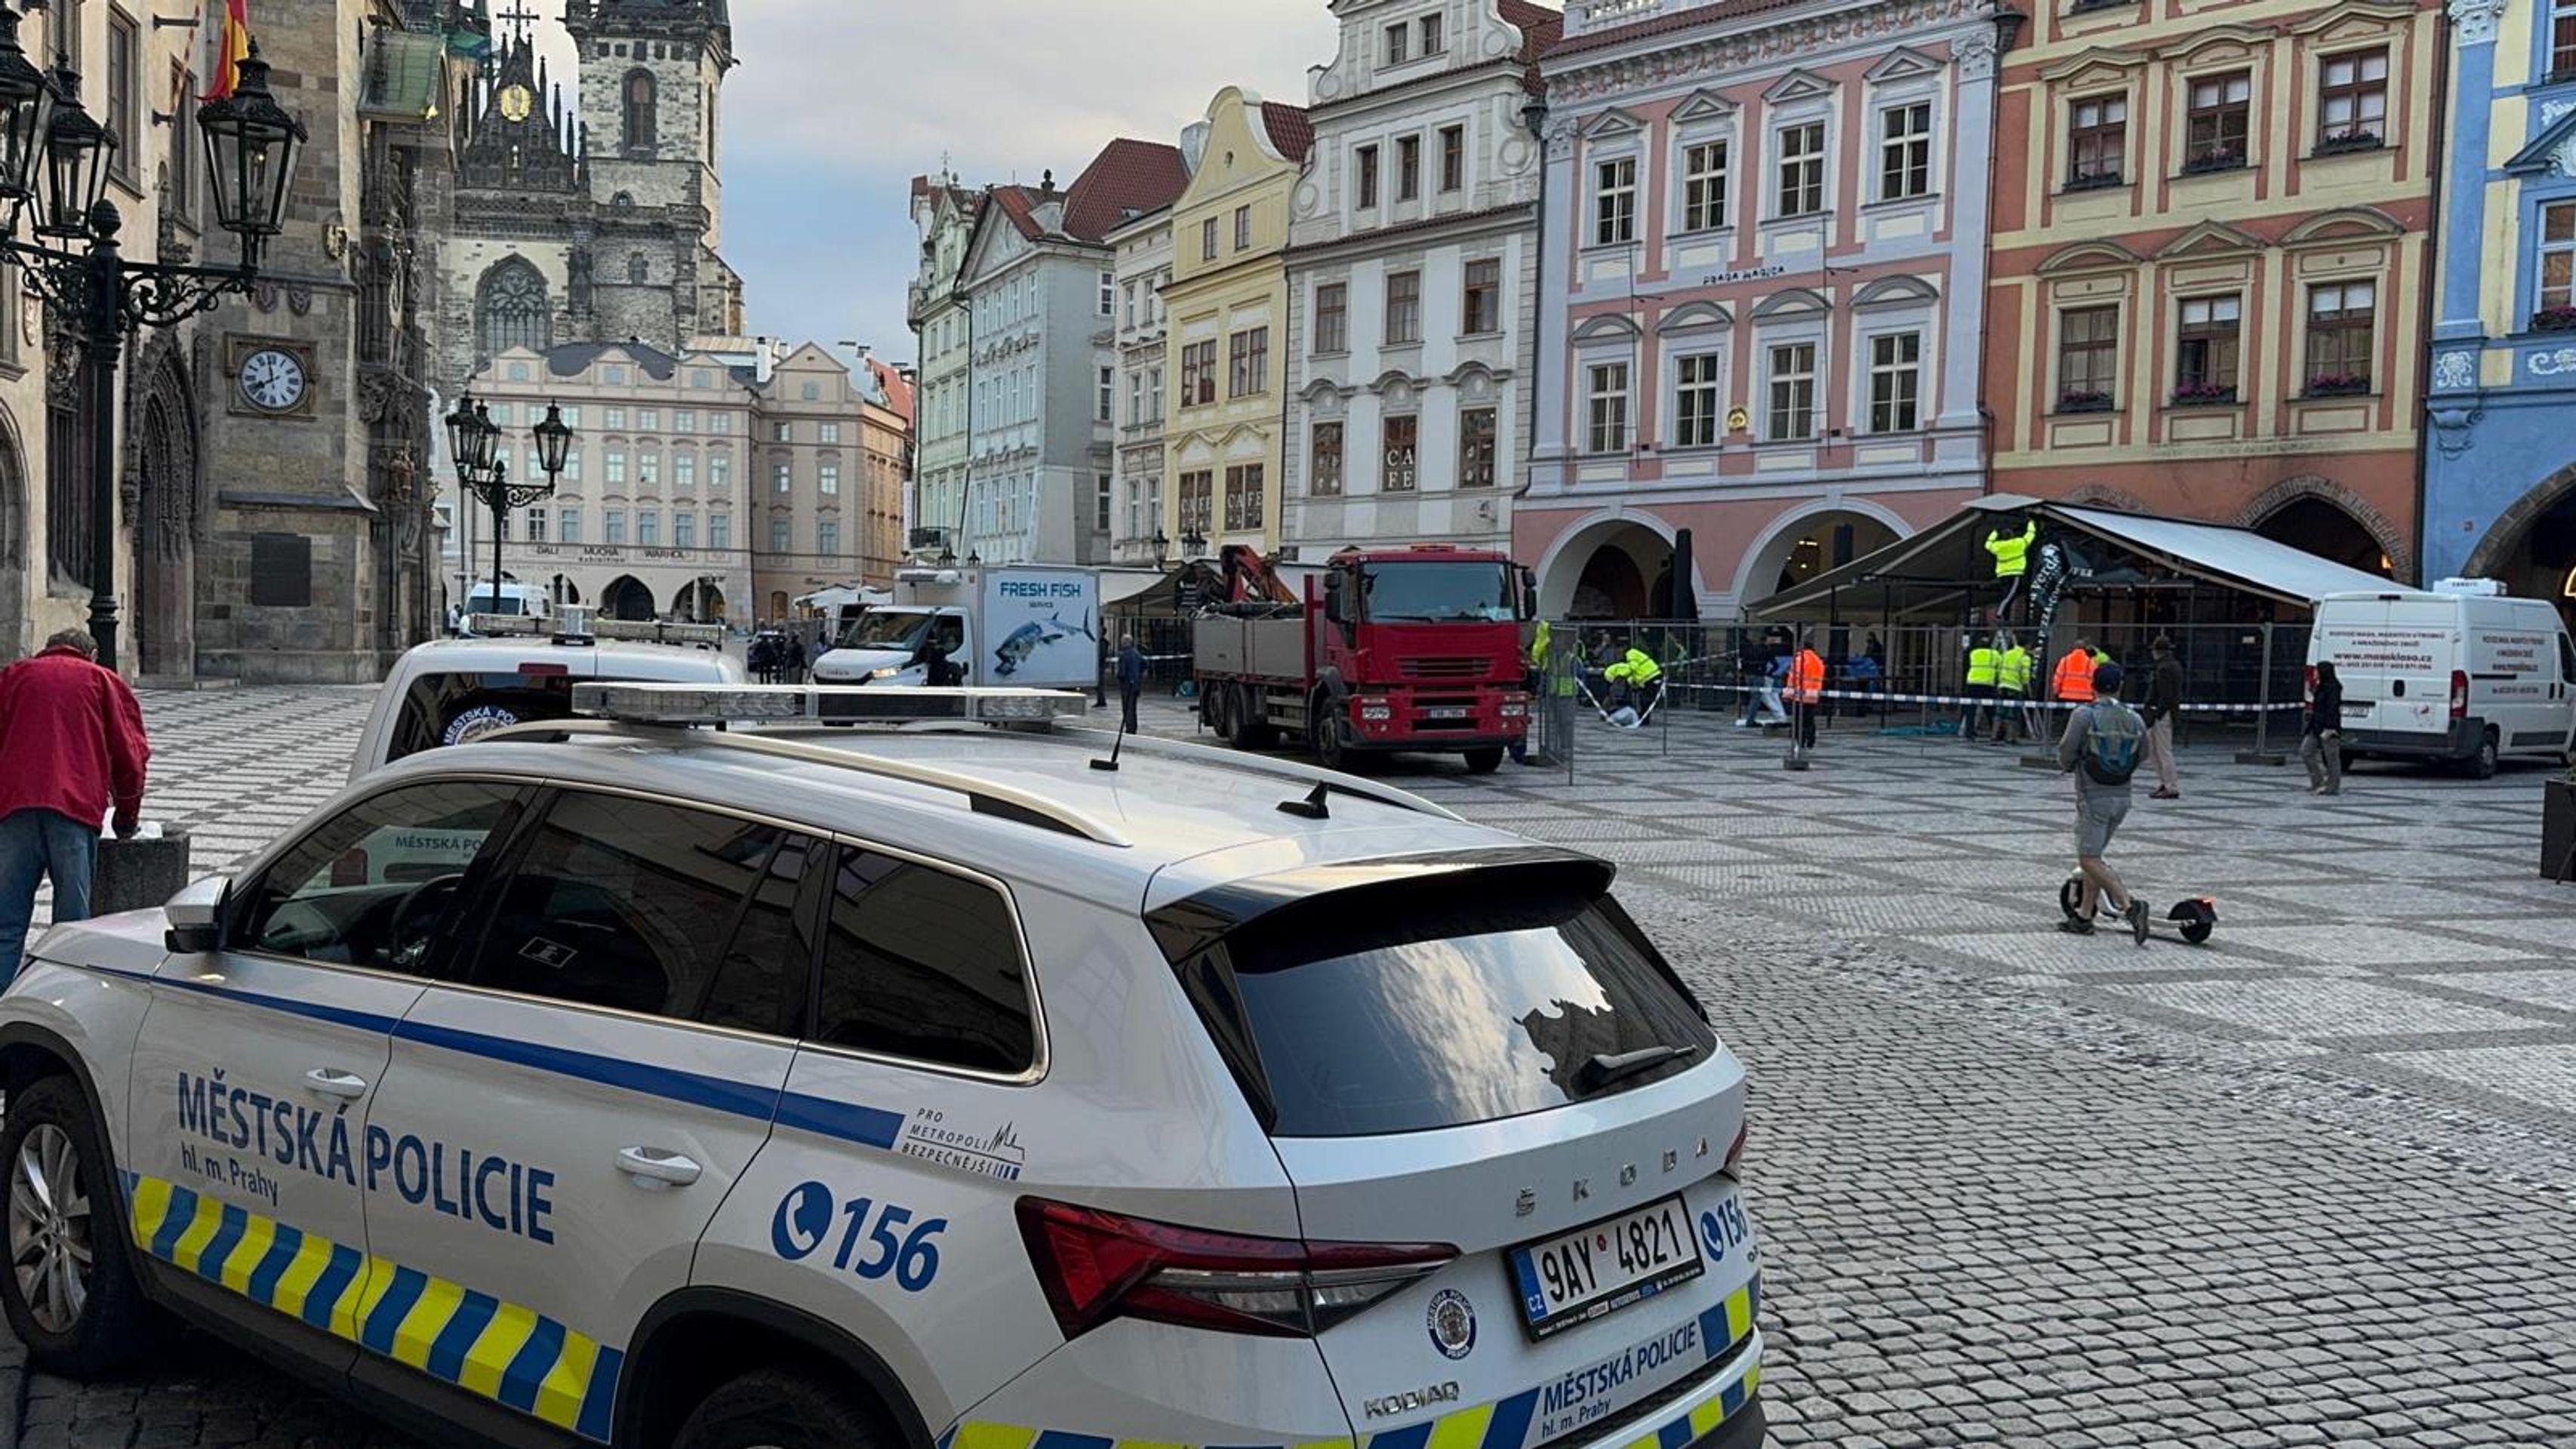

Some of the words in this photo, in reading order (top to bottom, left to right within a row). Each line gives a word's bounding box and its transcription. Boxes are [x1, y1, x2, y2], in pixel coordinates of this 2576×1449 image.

[1000, 582, 1048, 597] FRESH
[1051, 583, 1082, 598] FISH
[463, 838, 482, 851] PO
[916, 1107, 943, 1123] PRO
[179, 1066, 357, 1186] MĚSTSKÁ
[367, 1124, 555, 1245] POLICIE
[909, 1124, 988, 1151] METROPOLI
[181, 1140, 202, 1174] hl.
[205, 1156, 226, 1183] m.
[229, 1157, 278, 1207] Prahy
[833, 1197, 948, 1292] 156
[1542, 1237, 1597, 1303] 9AY
[1616, 1209, 1682, 1275] 4821
[1528, 1294, 1543, 1312] CZ
[1543, 1347, 1633, 1416] MĚSTSKÁ
[1637, 1321, 1696, 1377] POLICIE
[1364, 1380, 1460, 1420] KODIAQ
[1542, 1418, 1556, 1439] hl.
[1560, 1415, 1575, 1432] m.
[1579, 1398, 1611, 1423] Prahy
